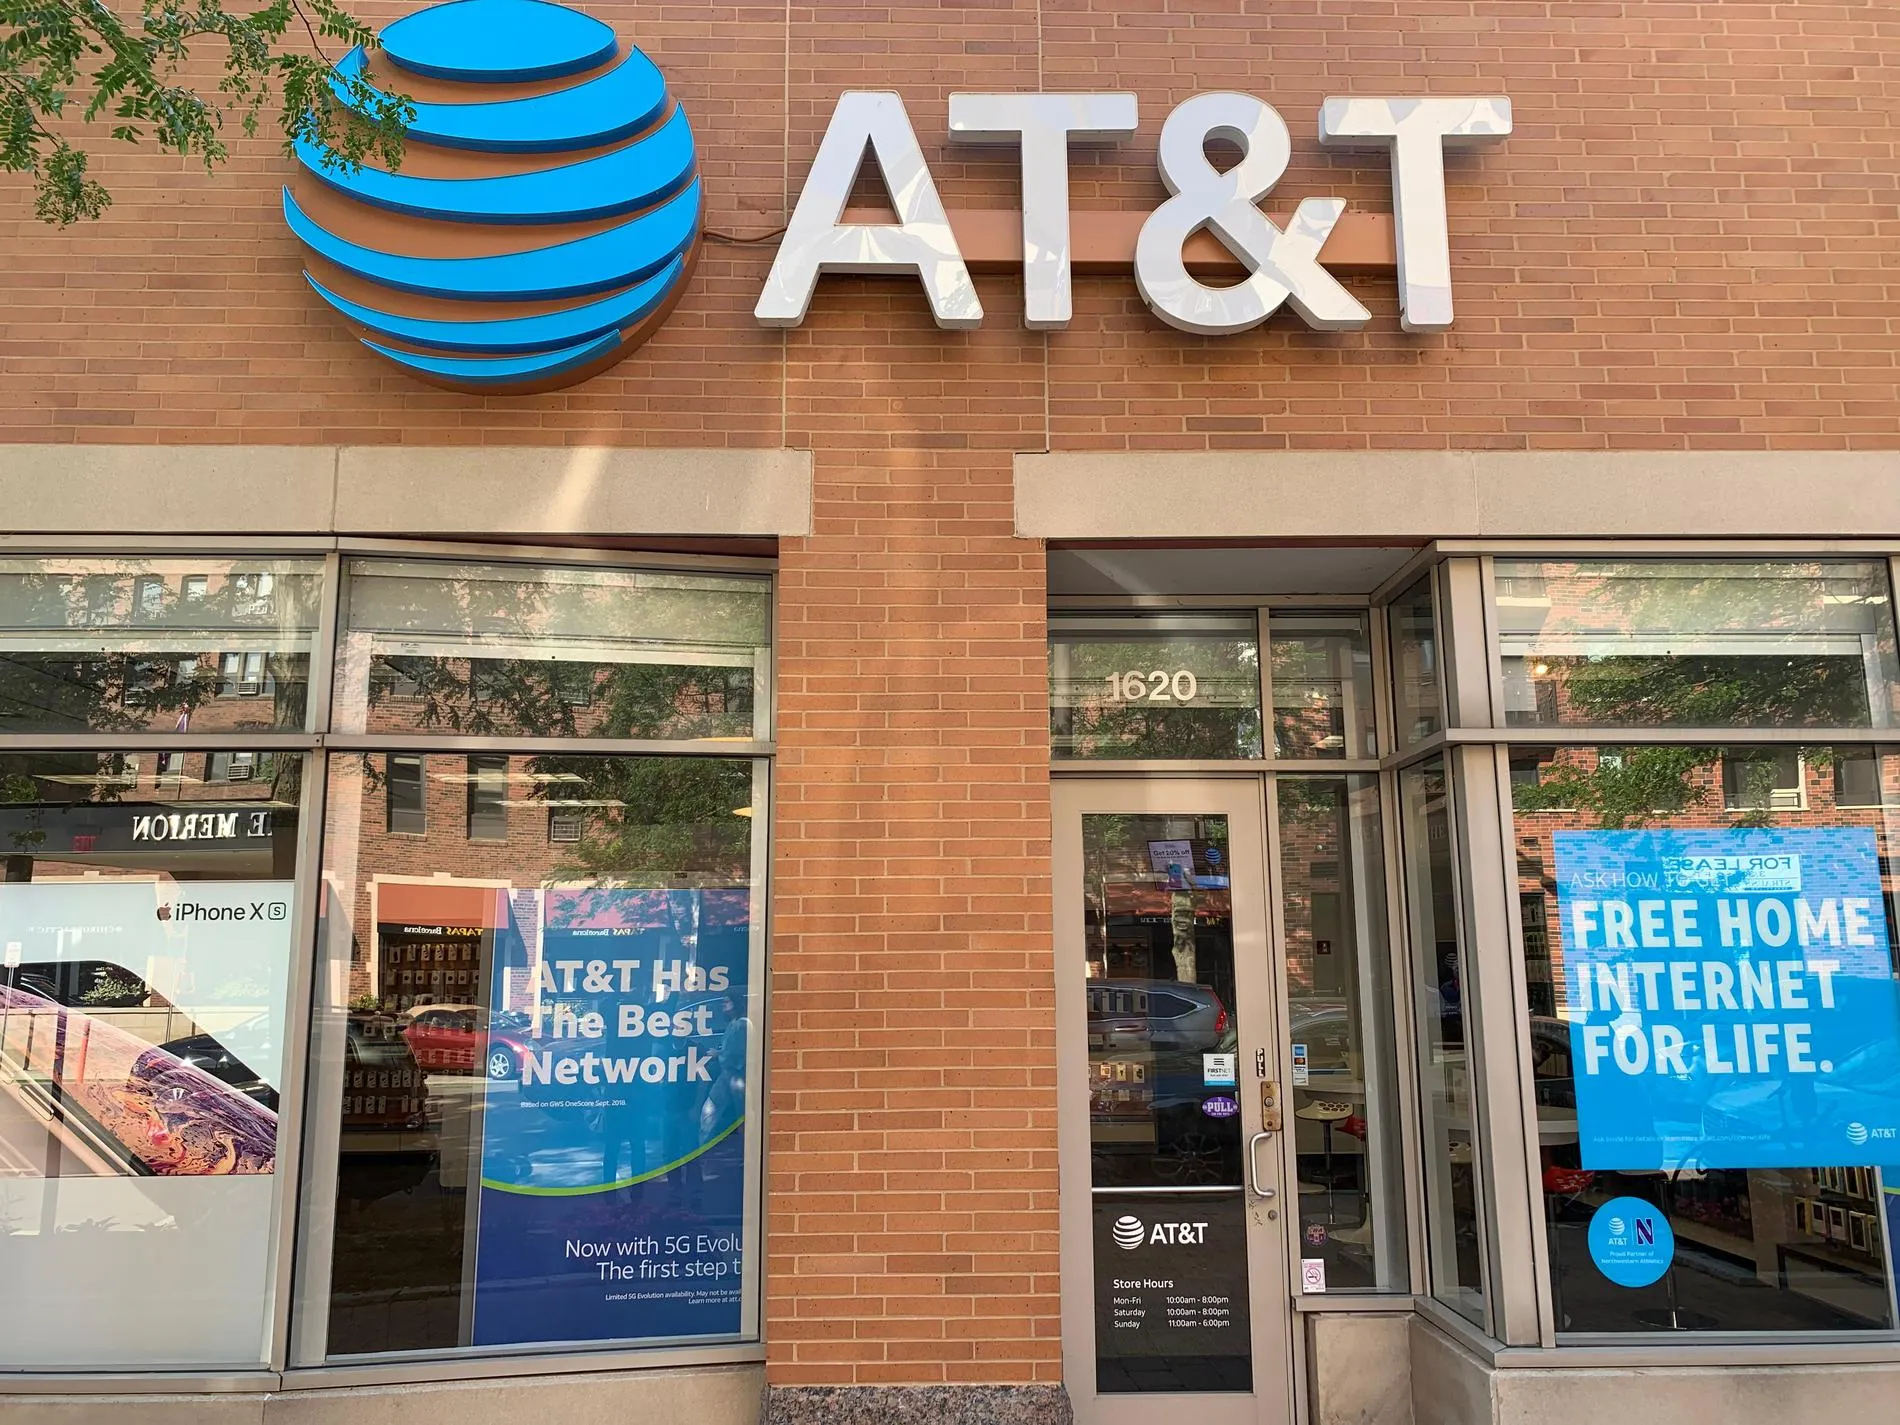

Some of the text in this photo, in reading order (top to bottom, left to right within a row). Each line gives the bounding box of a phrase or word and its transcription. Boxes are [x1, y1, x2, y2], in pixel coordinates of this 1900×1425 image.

[754, 90, 1513, 334] AT&T
[1105, 670, 1197, 701] 1620
[1570, 872, 1608, 888] ASK
[1612, 871, 1658, 888] HOW
[175, 903, 245, 920] iPhone
[1571, 897, 1874, 949] FREE HOME
[525, 959, 730, 994] AT&T Has
[1576, 960, 1840, 1012] INTERNET
[525, 1003, 713, 1039] The Best
[1582, 1023, 1834, 1075] FOR LIFE.
[522, 1046, 712, 1086] Network
[1207, 1102, 1233, 1112] PULL
[1871, 1128, 1896, 1139] AT&T
[1150, 1222, 1208, 1244] AT&T
[1608, 1217, 1654, 1246] AT&T N
[565, 1233, 742, 1258] Now with 5G Evolu
[596, 1261, 634, 1281] The
[639, 1259, 680, 1279] first
[685, 1260, 727, 1281] step
[1113, 1279, 1174, 1289] Store Hours
[605, 1292, 628, 1301] Limited
[637, 1292, 664, 1300] Evolution
[696, 1290, 708, 1298] May
[1113, 1296, 1142, 1305] Mon-Fri
[1166, 1296, 1196, 1304] 10:00am
[1201, 1296, 1229, 1305] 8:00pm
[1114, 1308, 1146, 1318] Saturday
[1166, 1308, 1196, 1316] 10:00am
[1202, 1308, 1229, 1317] 8:00pm
[1114, 1320, 1140, 1329] Sunday
[1203, 1319, 1230, 1328] 6:00pm
